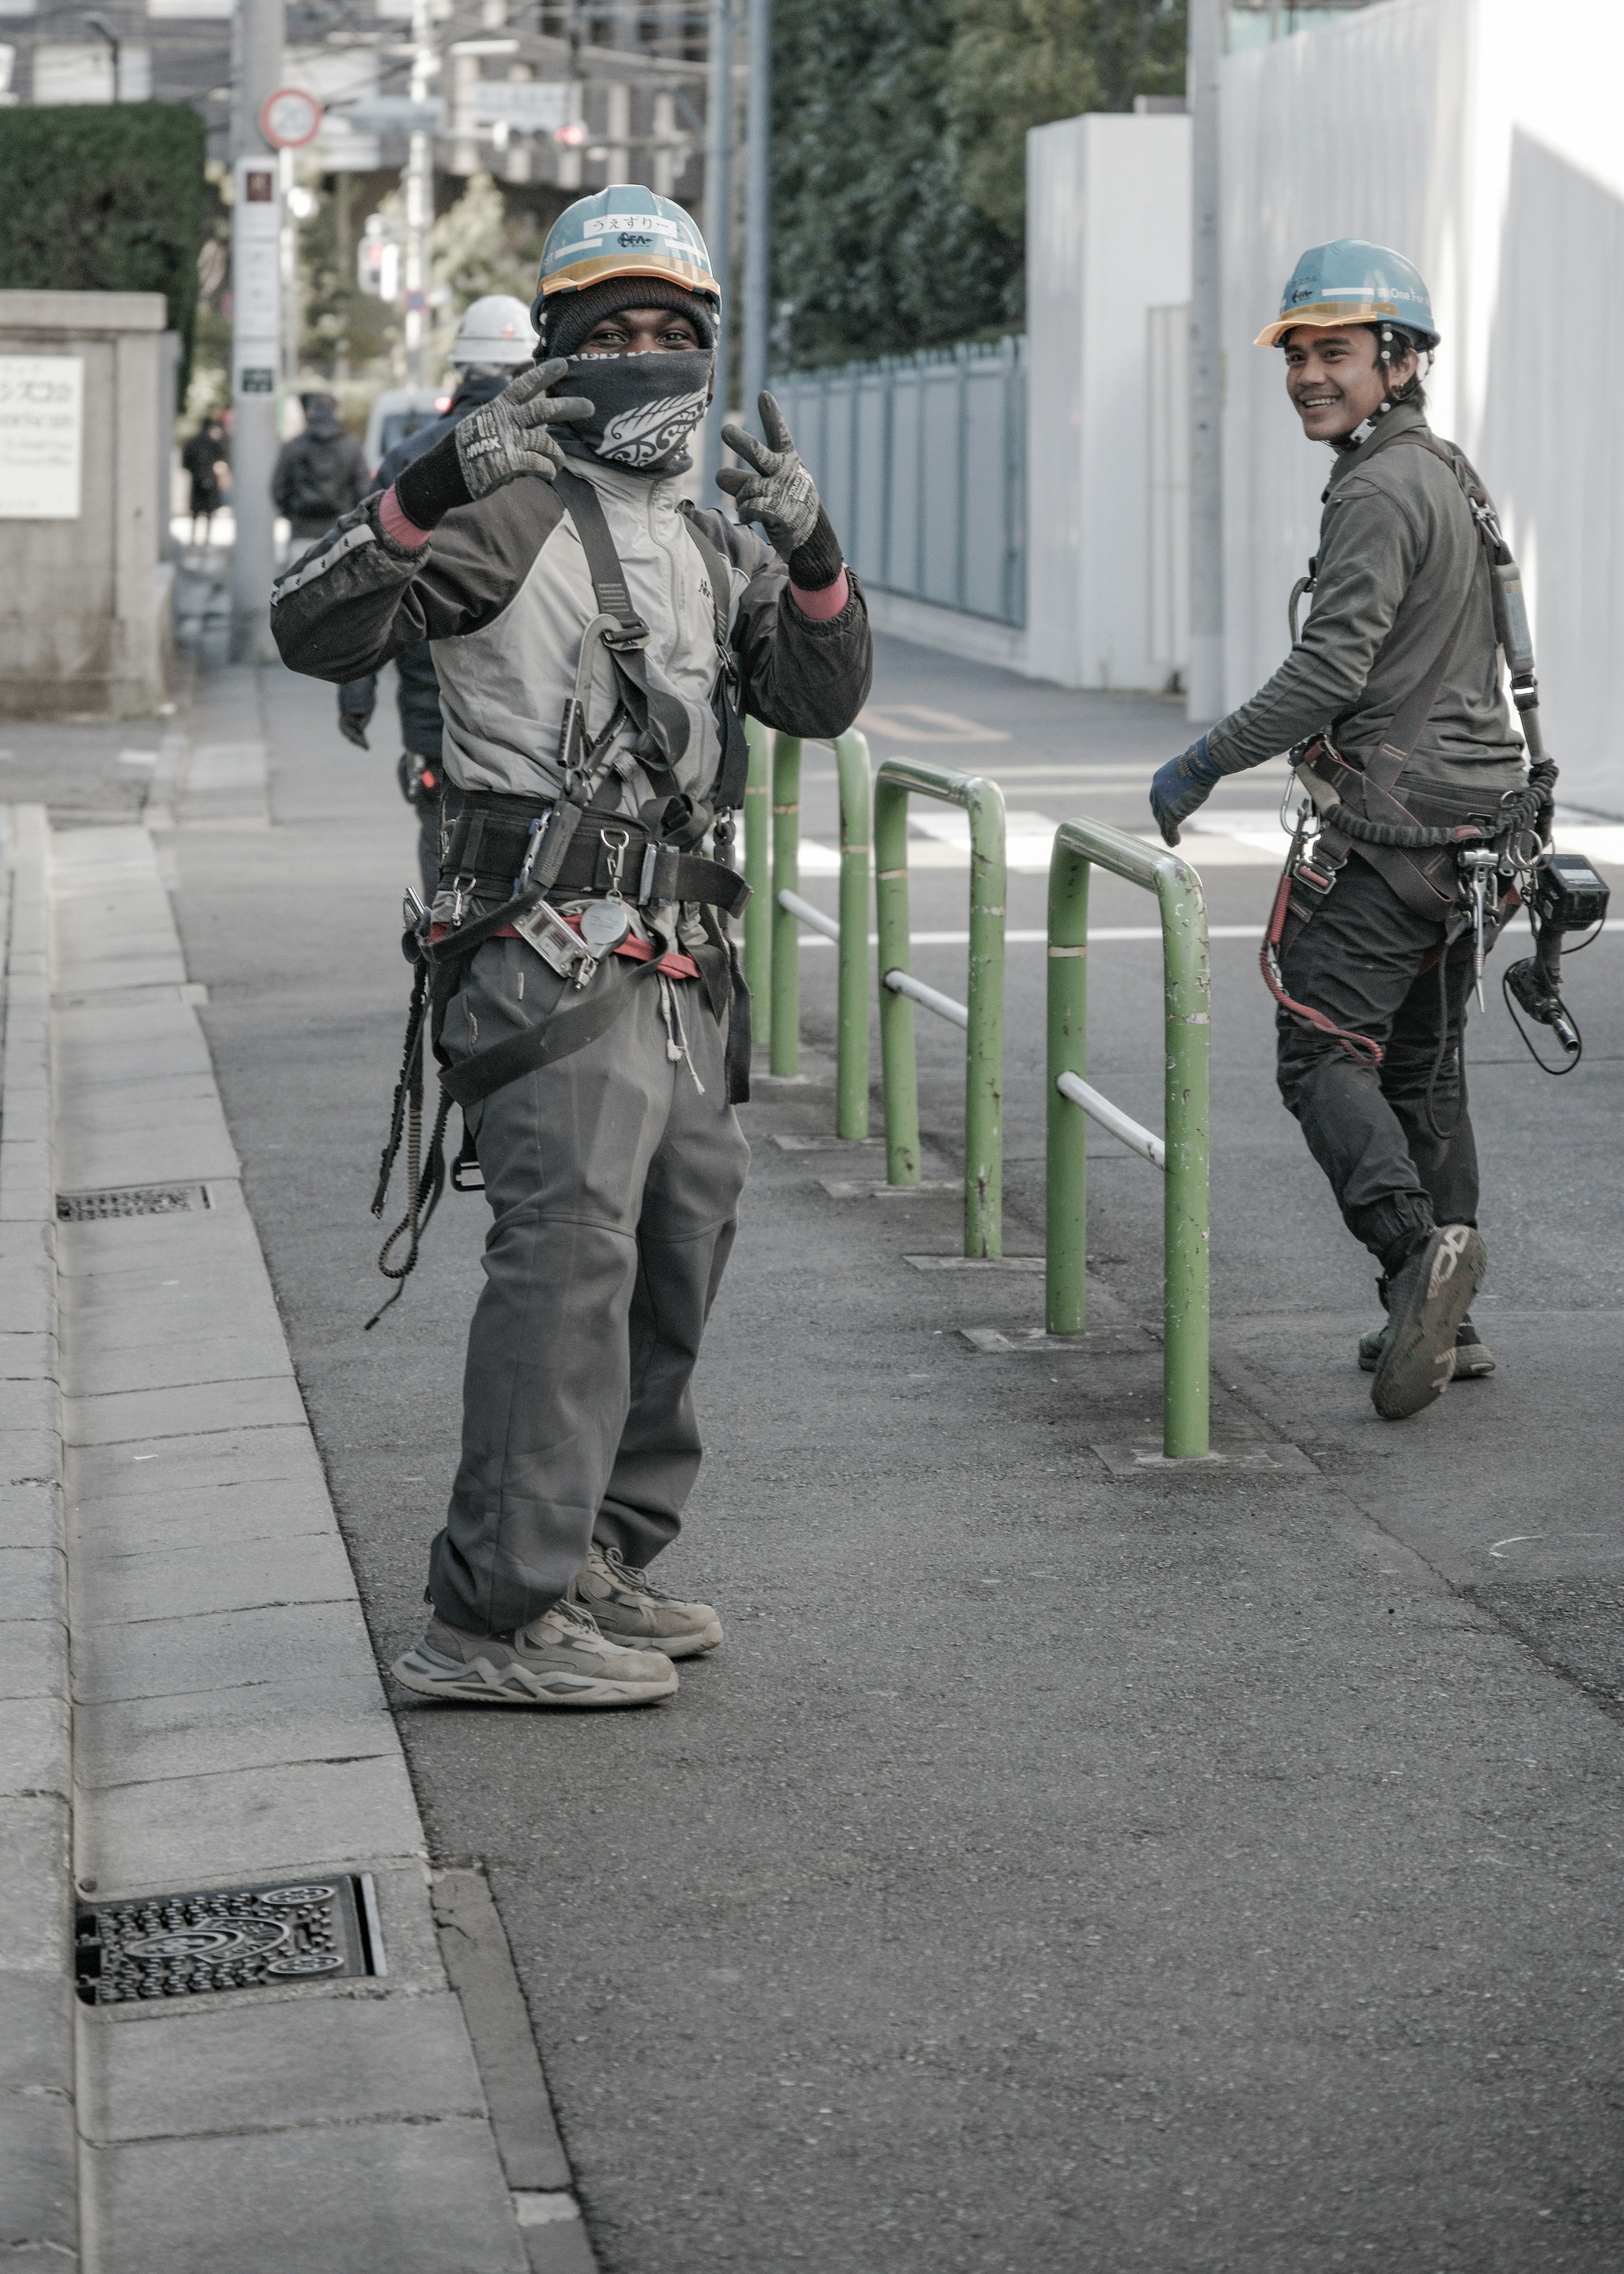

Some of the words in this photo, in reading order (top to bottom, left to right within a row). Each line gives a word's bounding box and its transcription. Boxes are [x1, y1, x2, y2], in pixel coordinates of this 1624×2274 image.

[593, 216, 669, 231] うえずりー
[1391, 288, 1410, 300] One
